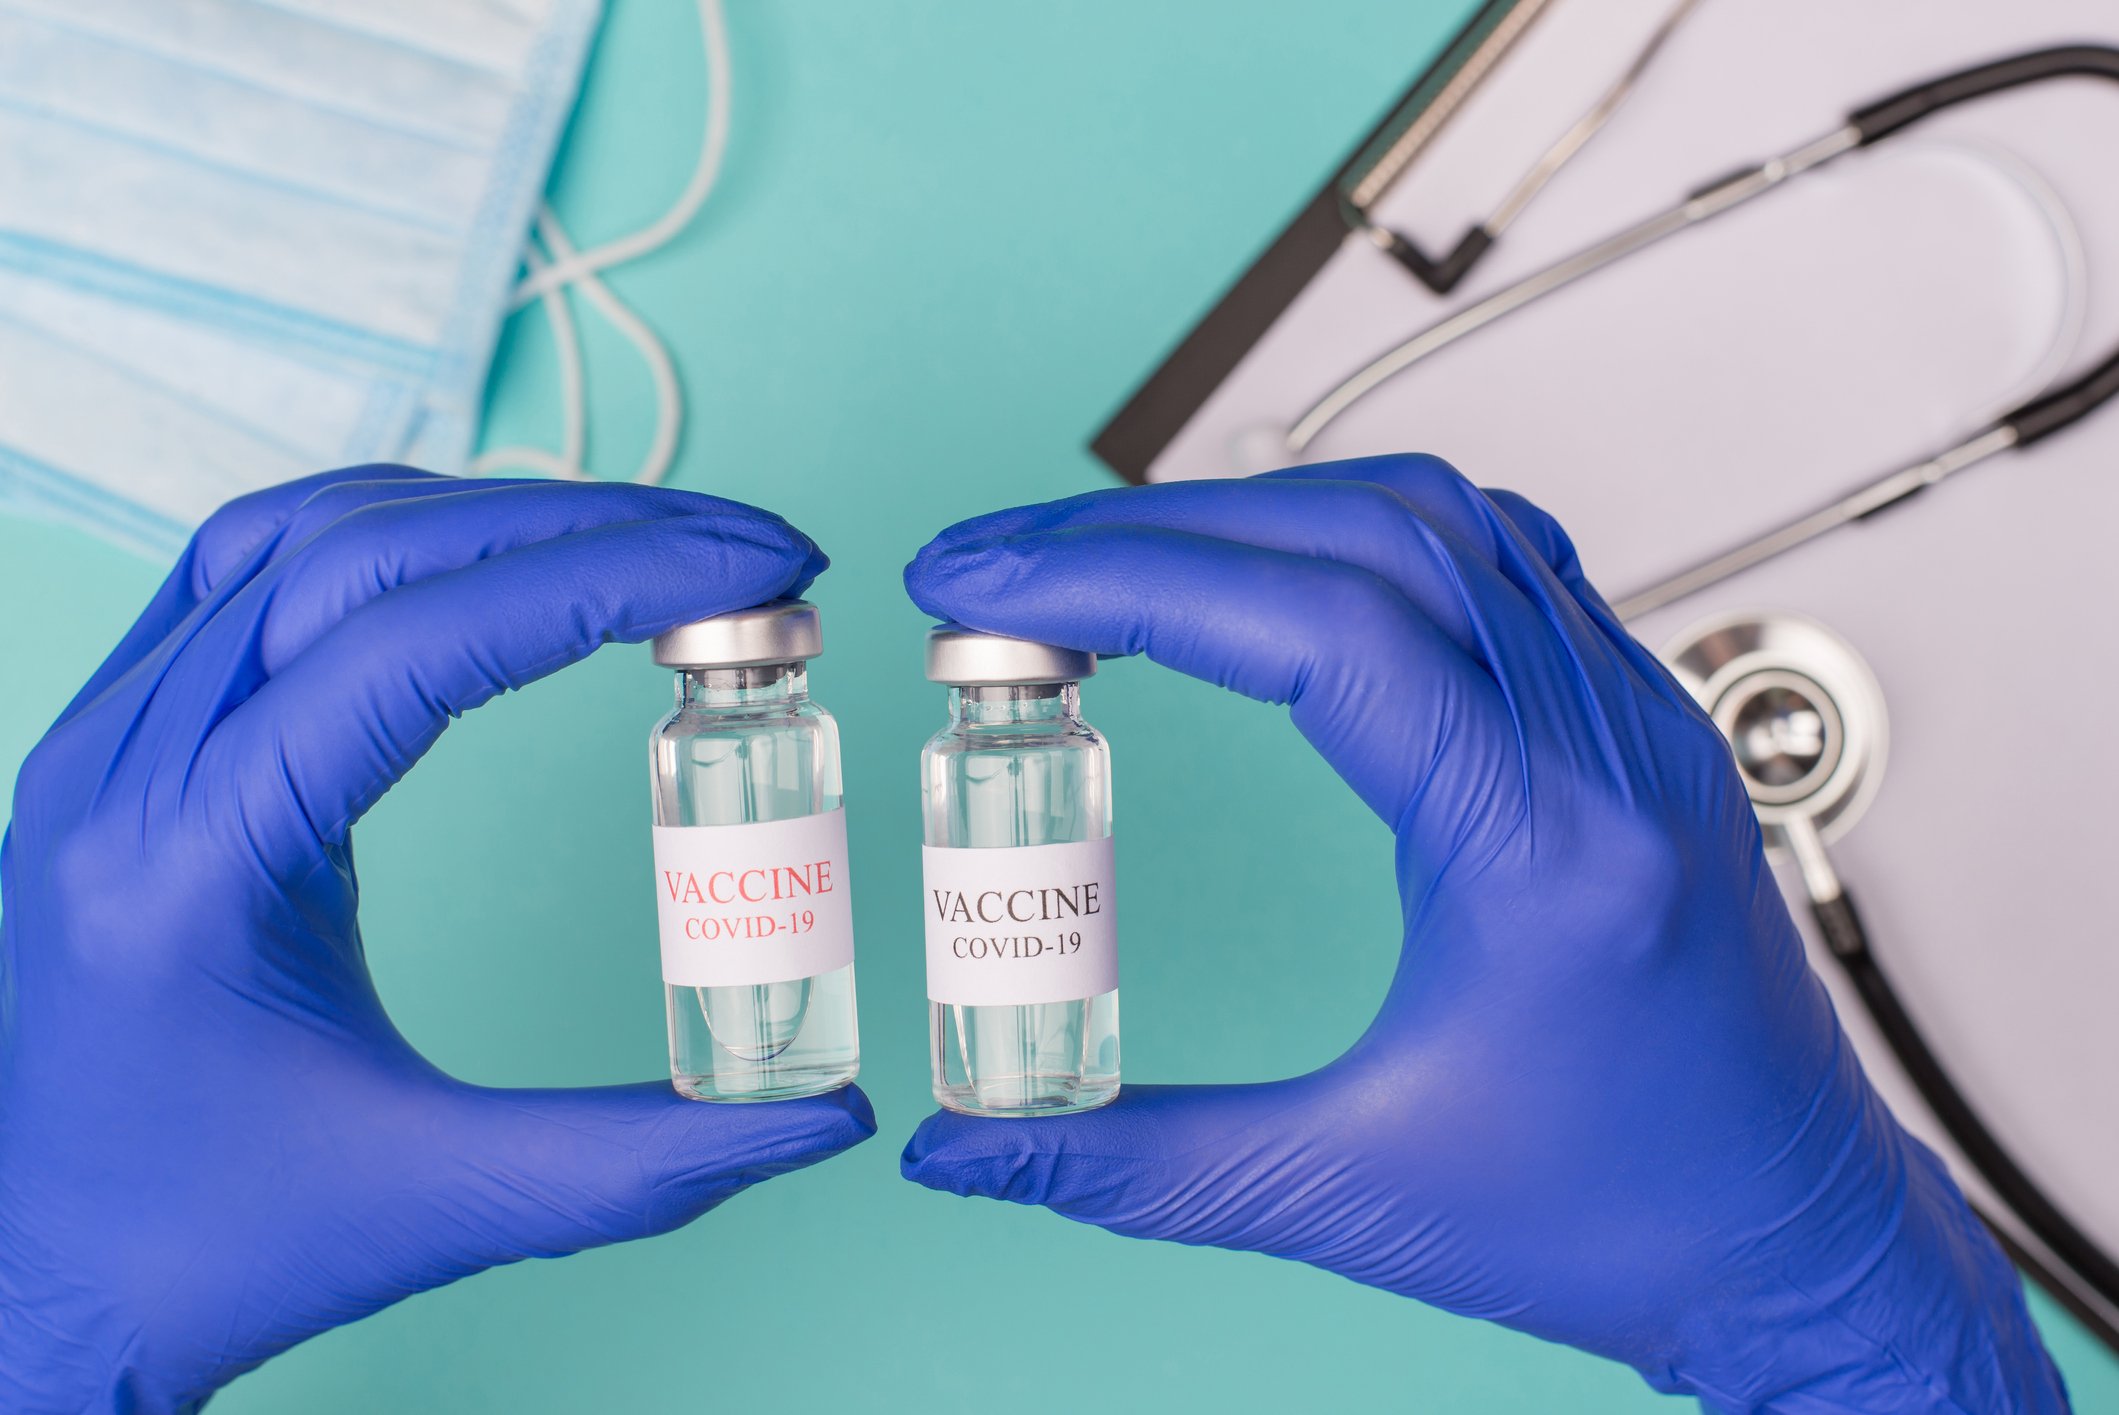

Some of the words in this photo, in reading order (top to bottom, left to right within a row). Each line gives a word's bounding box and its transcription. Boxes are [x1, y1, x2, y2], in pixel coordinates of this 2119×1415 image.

[664, 860, 834, 904] VACCINE
[933, 882, 1102, 924] VACCINE
[685, 910, 815, 940] COVID-19
[953, 931, 1082, 959] COVID-19
